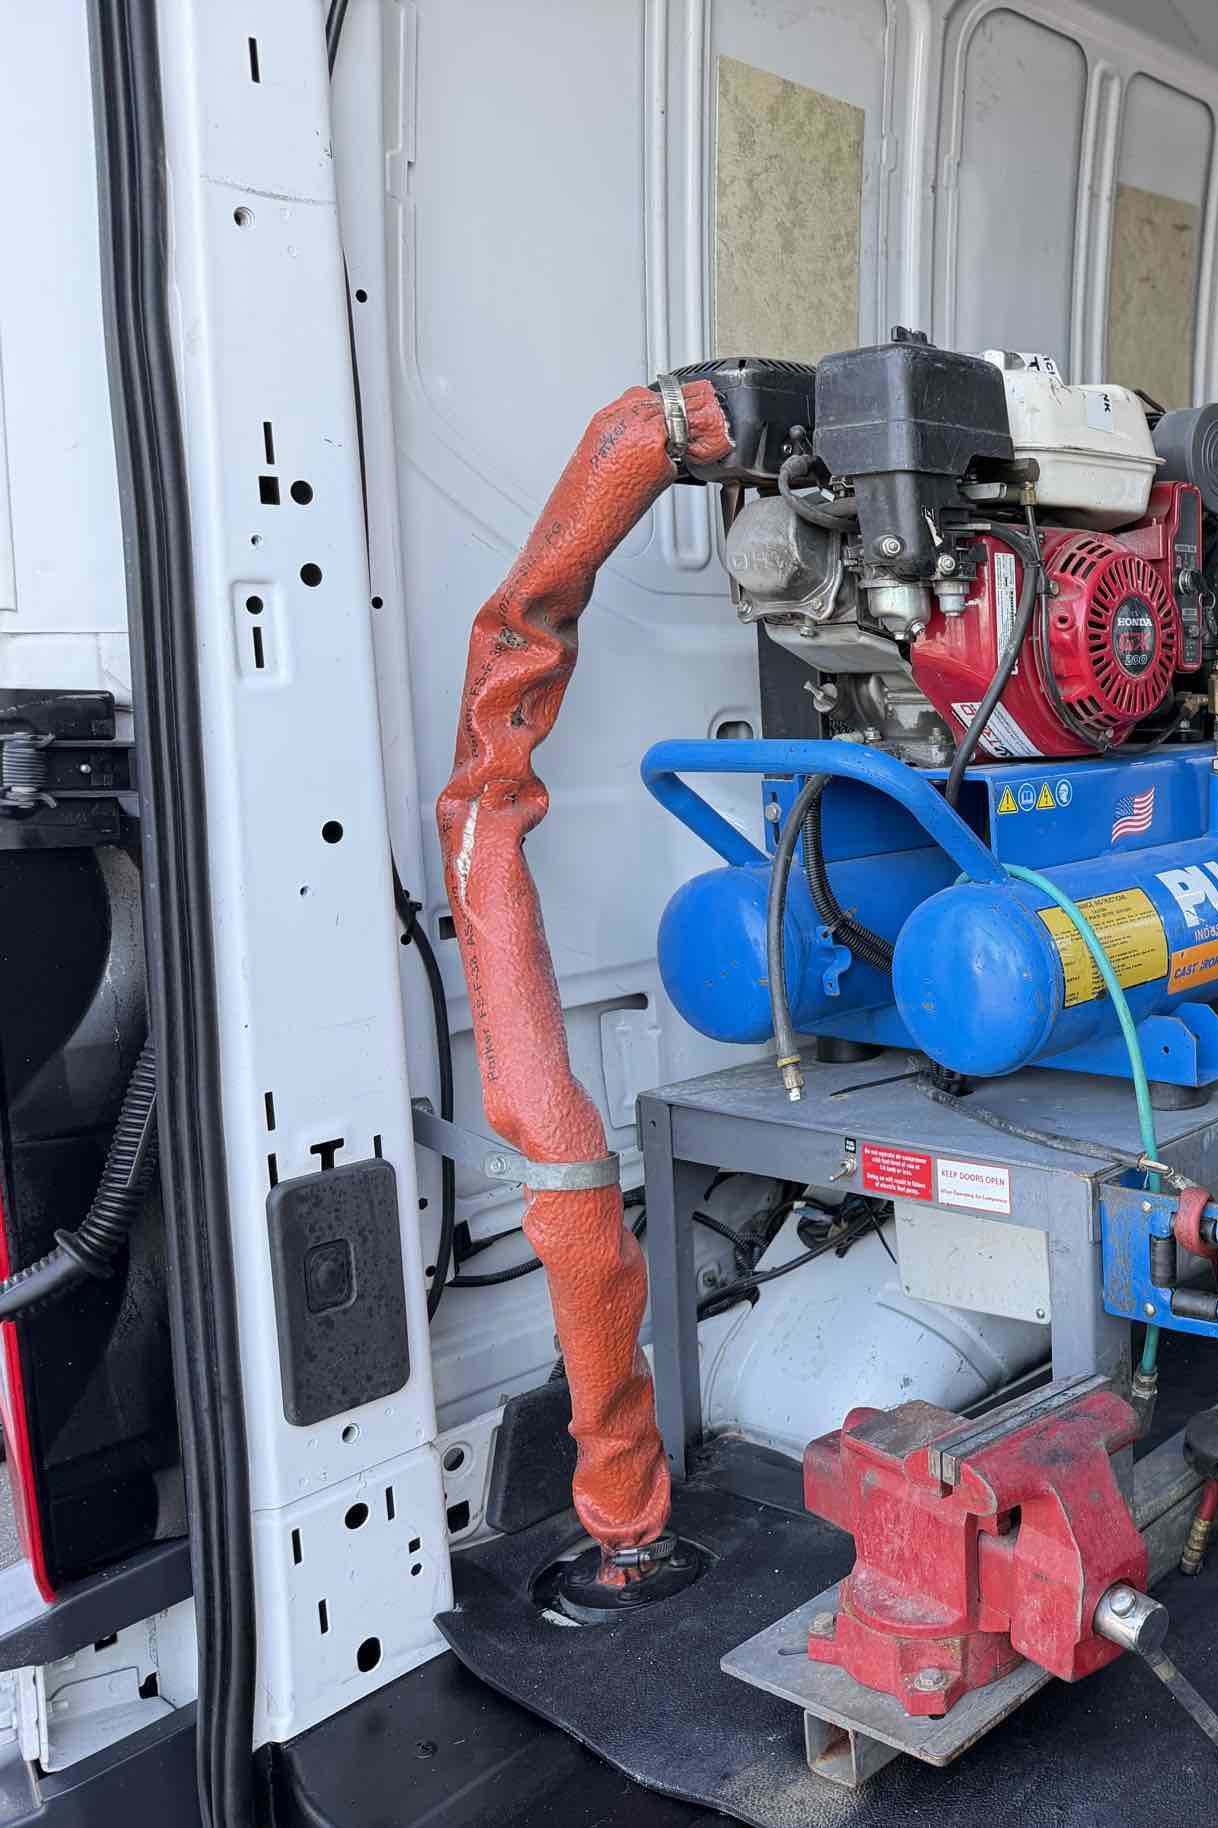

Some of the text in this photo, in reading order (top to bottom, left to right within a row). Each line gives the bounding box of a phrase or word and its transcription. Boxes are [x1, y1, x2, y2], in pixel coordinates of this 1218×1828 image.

[1117, 617, 1153, 627] HONDA
[941, 1168, 1005, 1187] KEEP DOORS OPEN
